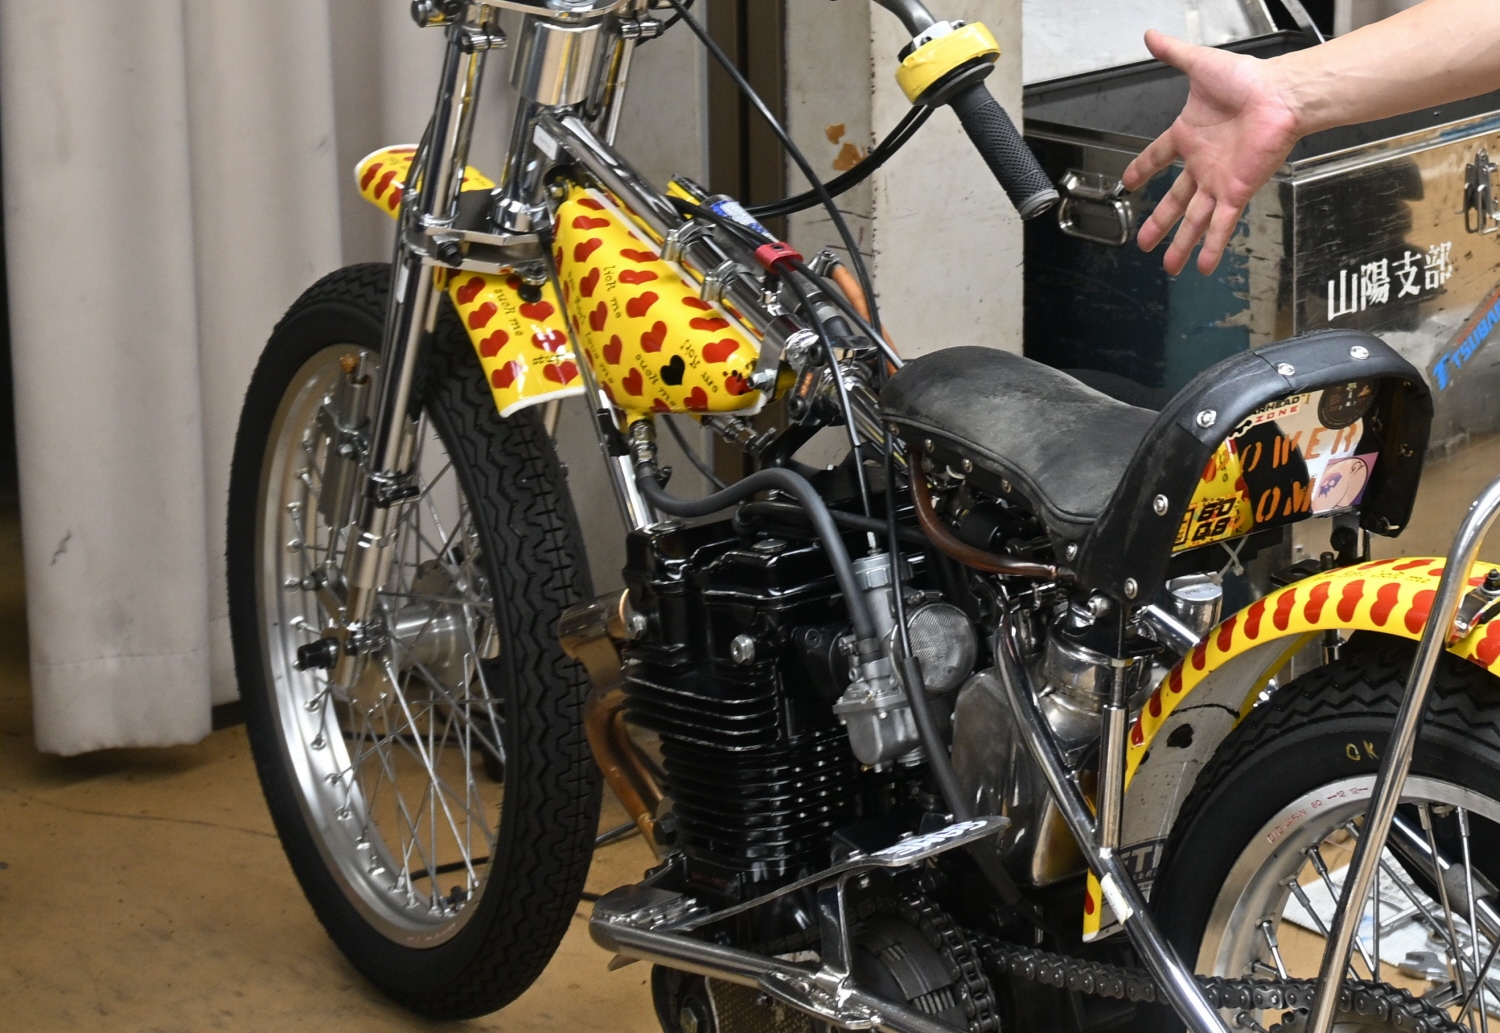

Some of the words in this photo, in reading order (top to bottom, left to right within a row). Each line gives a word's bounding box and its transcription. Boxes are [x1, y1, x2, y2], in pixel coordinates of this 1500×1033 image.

[1327, 241, 1453, 322] 山陽支部
[1255, 405, 1299, 423] ZONE
[1345, 740, 1380, 762] OK
